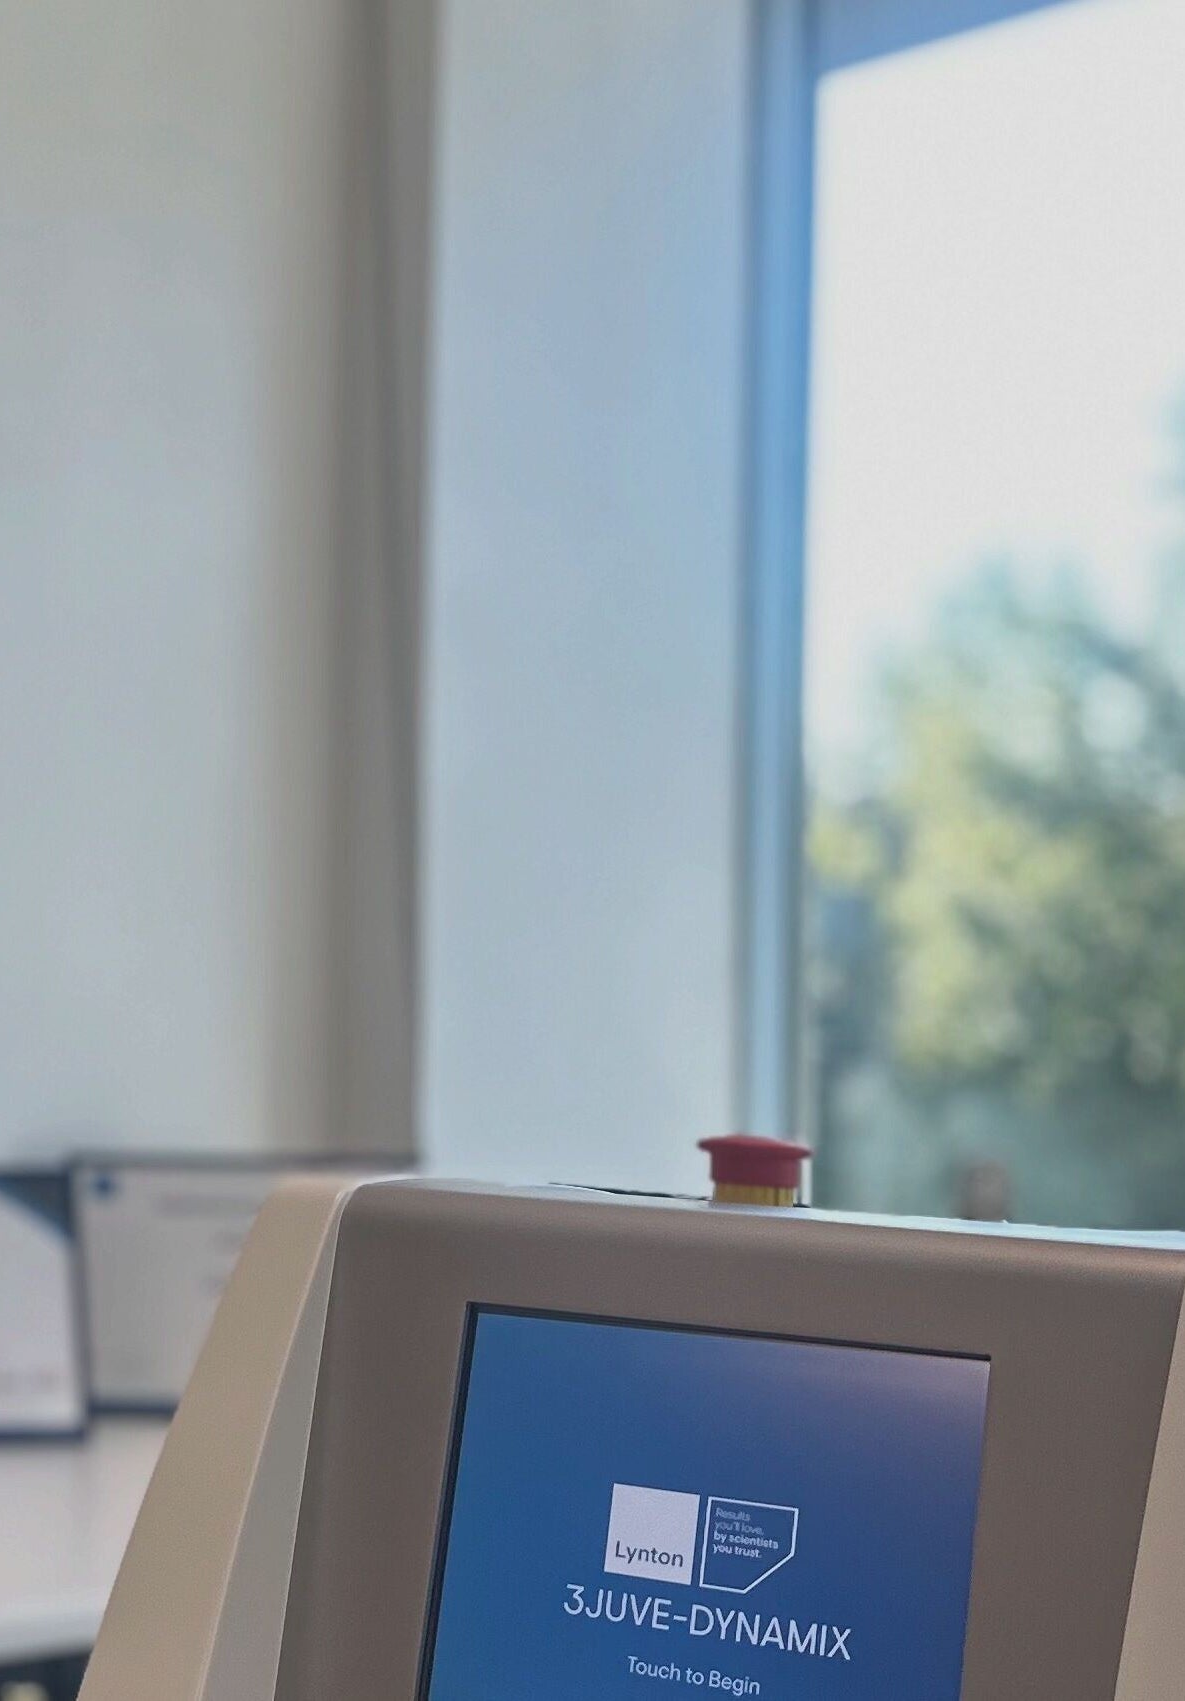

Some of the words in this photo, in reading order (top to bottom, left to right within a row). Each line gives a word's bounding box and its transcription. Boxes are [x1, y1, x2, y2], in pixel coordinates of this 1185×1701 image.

[716, 1508, 751, 1521] Results
[712, 1543, 732, 1554] you
[735, 1546, 763, 1558] trust.
[713, 1530, 727, 1543] by
[729, 1534, 778, 1549] scientists
[615, 1540, 684, 1568] Lynton
[563, 1583, 852, 1661] 3JUVE-DYNAMIX
[627, 1655, 681, 1682] Touch
[685, 1667, 705, 1686] to
[708, 1670, 761, 1696] Begin
